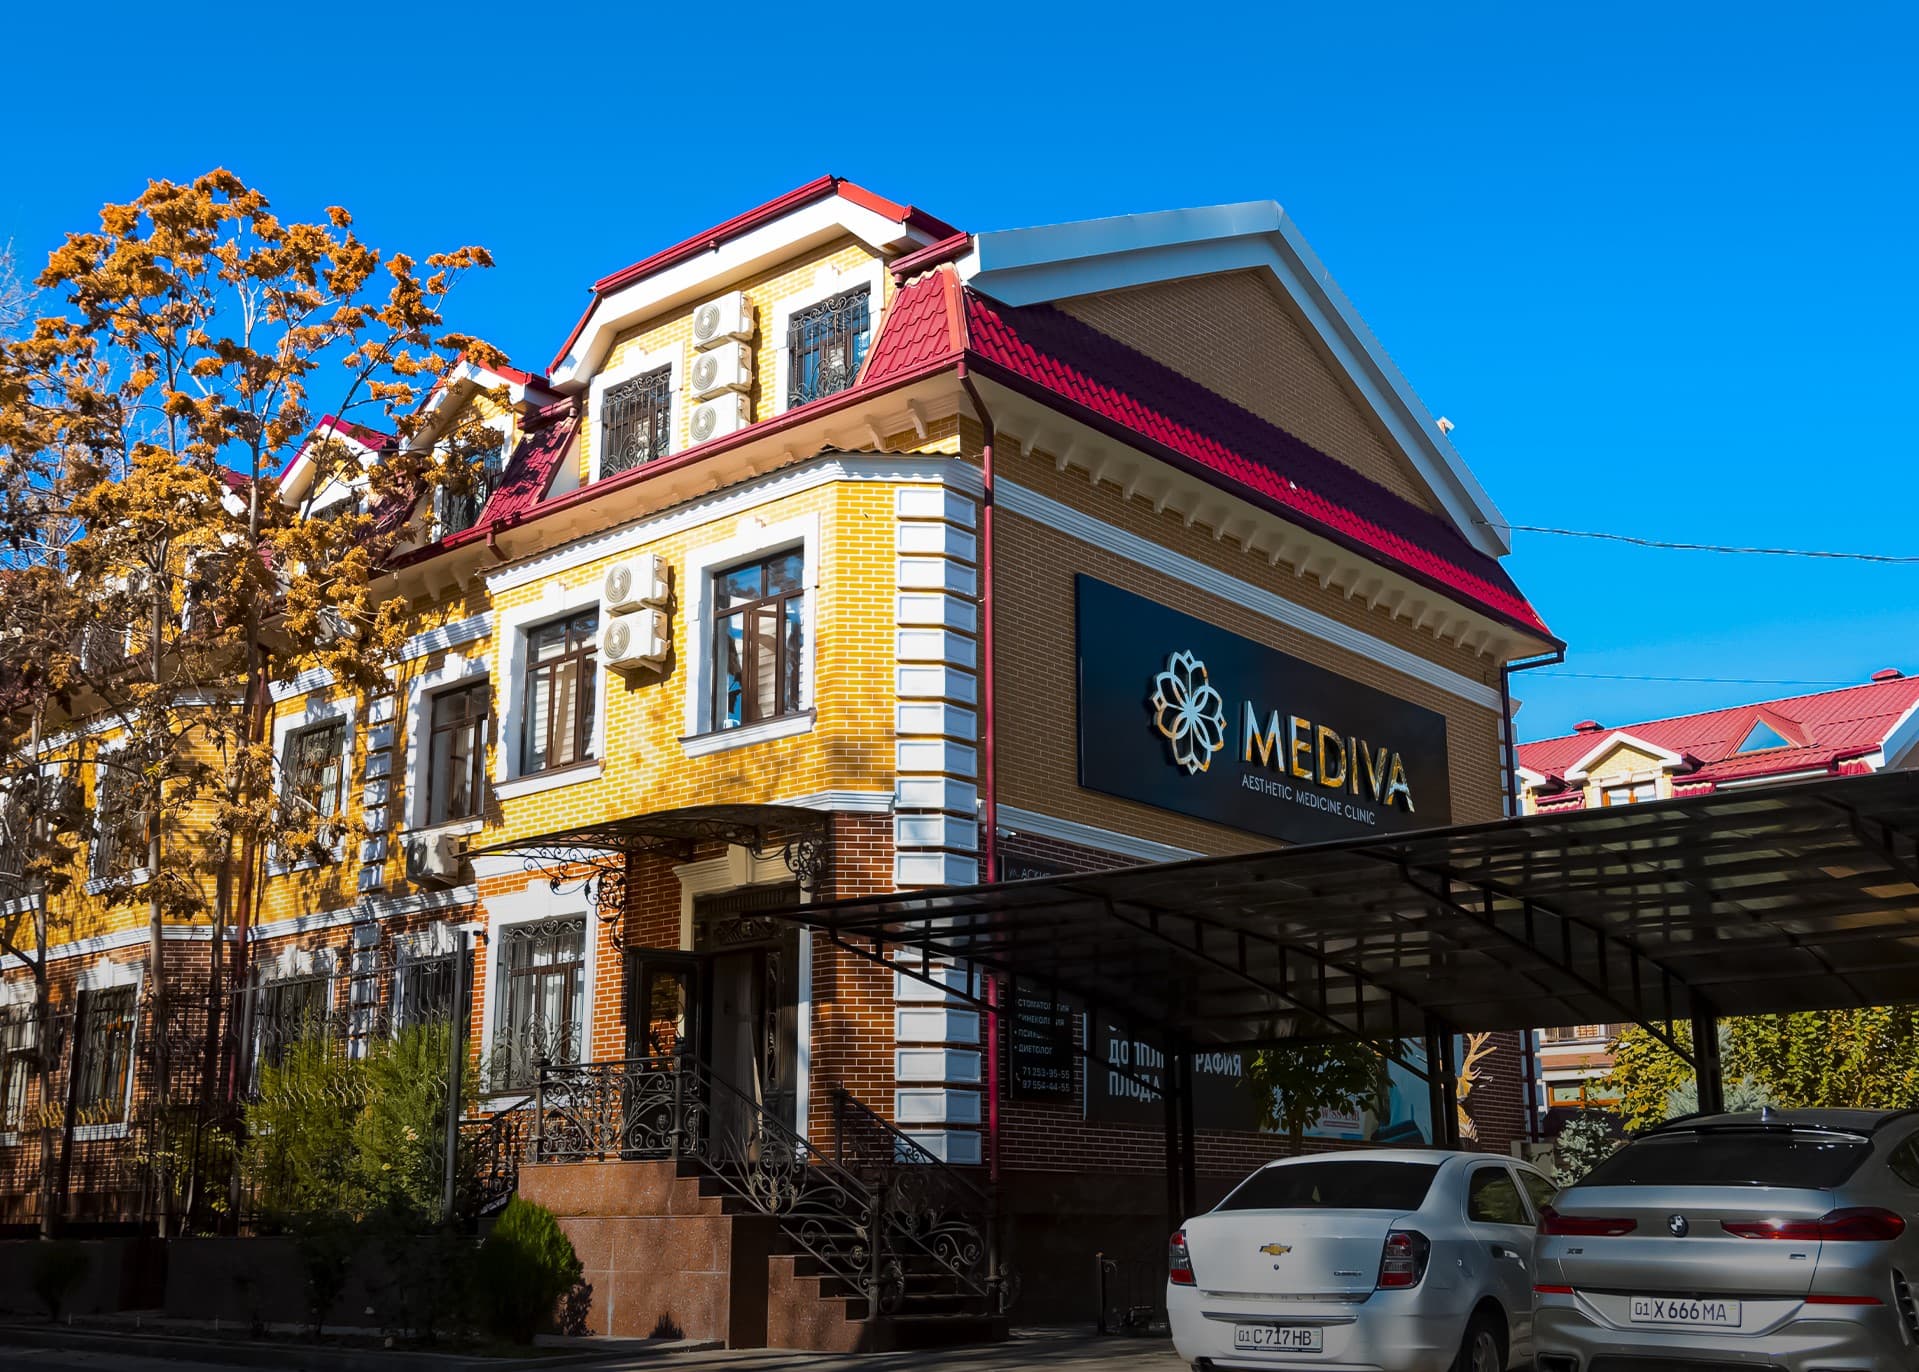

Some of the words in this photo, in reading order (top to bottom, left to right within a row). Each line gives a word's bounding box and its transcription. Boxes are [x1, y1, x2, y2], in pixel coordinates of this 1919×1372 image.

[1243, 699, 1415, 813] MEDIVA
[1241, 773, 1293, 801] AESTHETIC
[1296, 790, 1343, 816] MEDICINE
[1344, 804, 1376, 825] CLINIC
[1108, 1070, 1163, 1104] ПЛОДА
